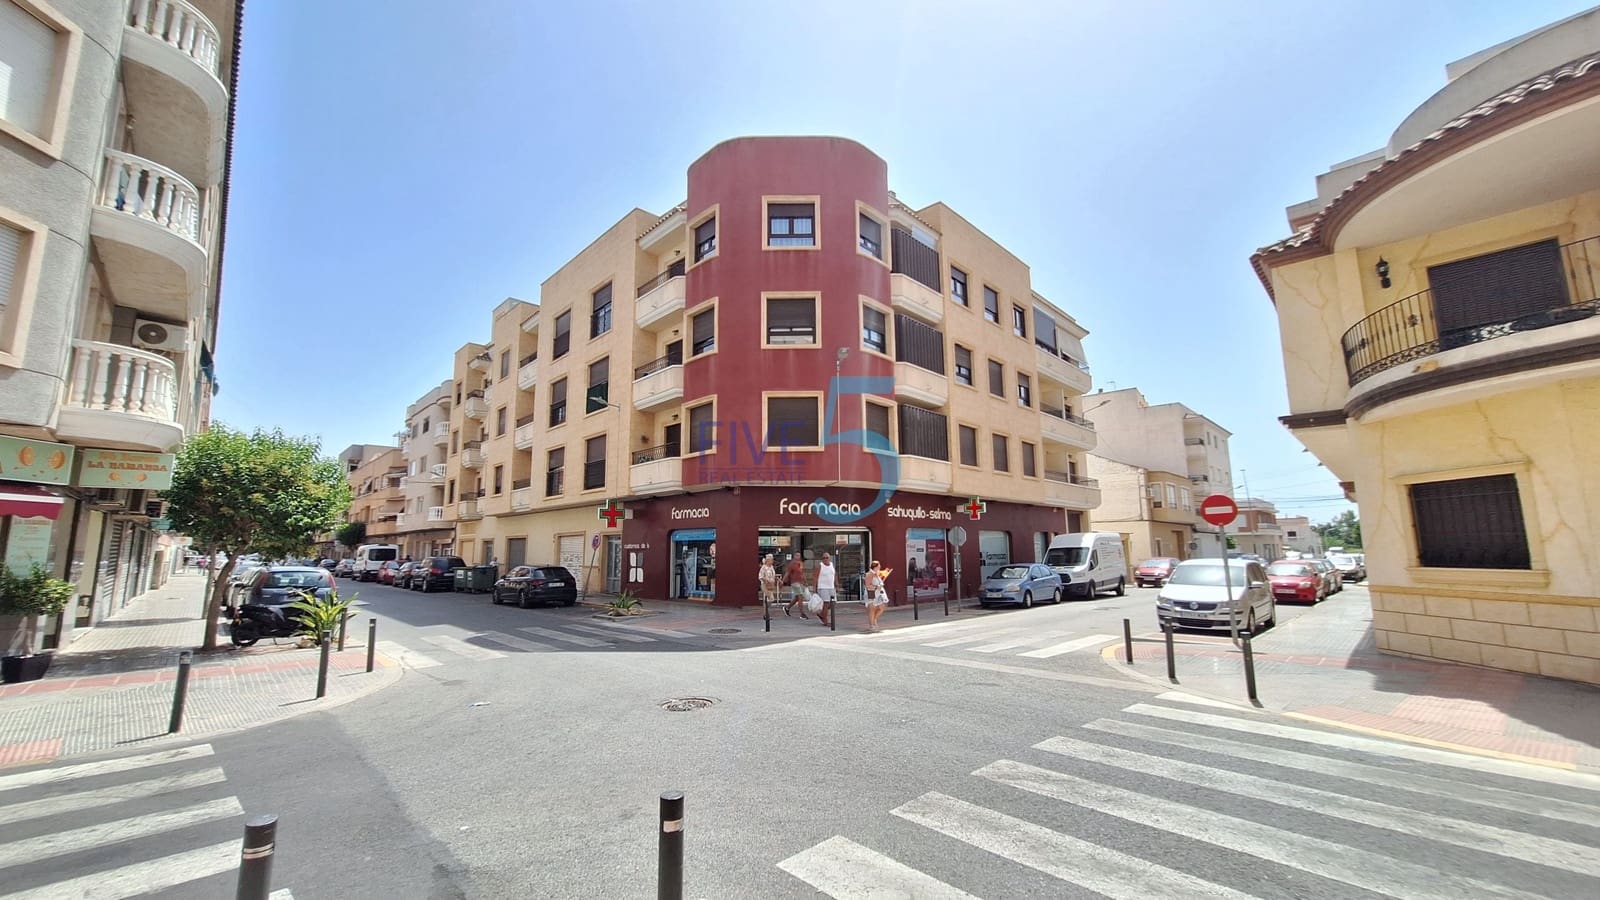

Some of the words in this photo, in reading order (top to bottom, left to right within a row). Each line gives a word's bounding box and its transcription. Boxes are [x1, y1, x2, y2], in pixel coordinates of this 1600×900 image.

[87, 461, 104, 469] LA
[671, 507, 710, 520] farmacia
[779, 498, 861, 516] farmacia
